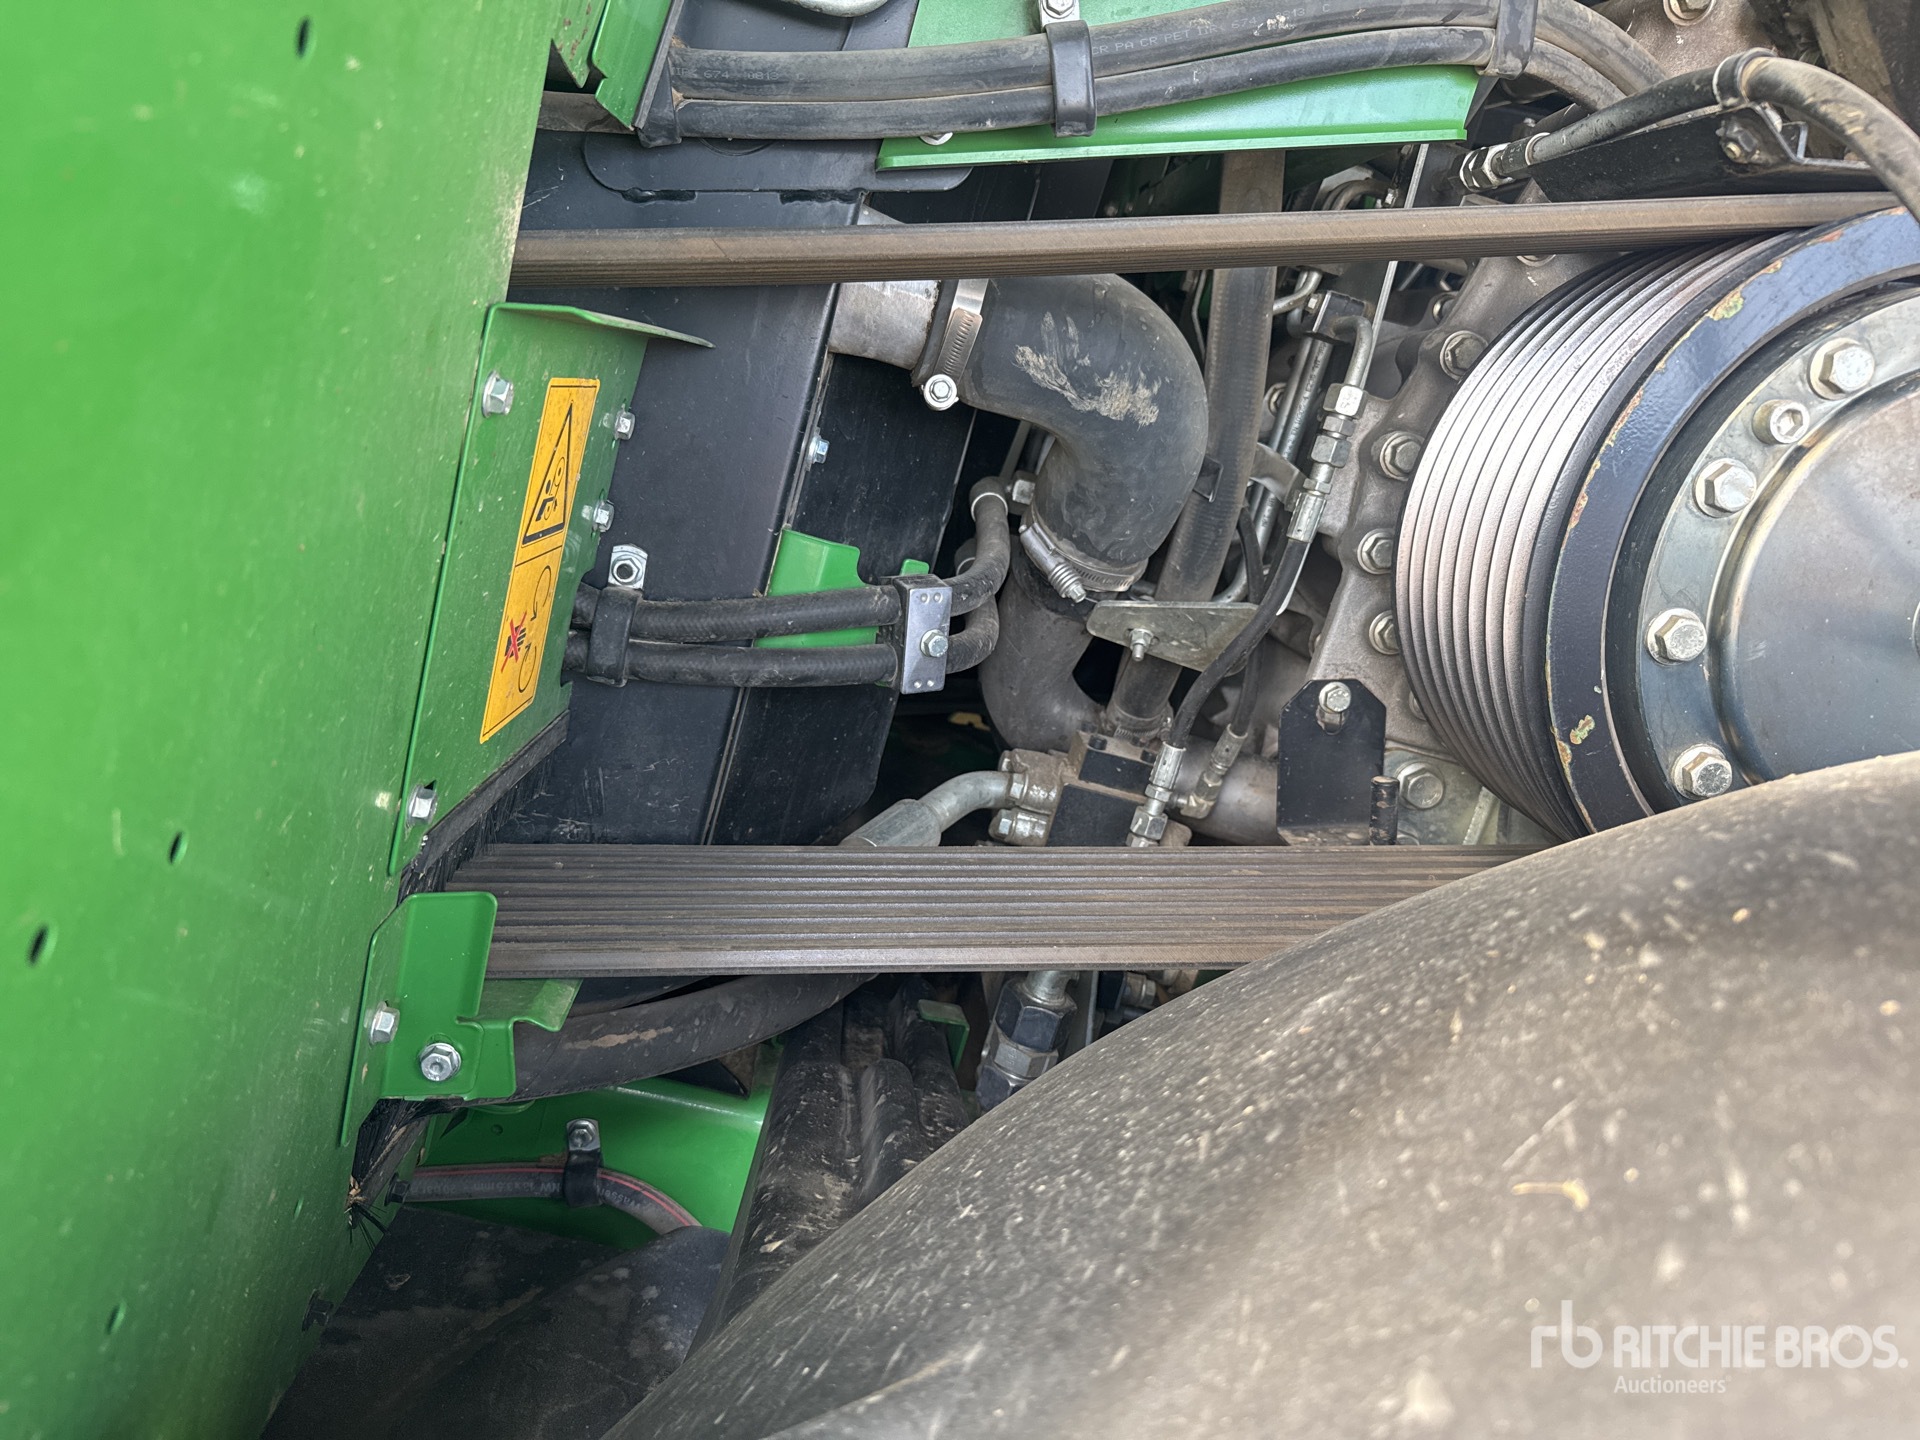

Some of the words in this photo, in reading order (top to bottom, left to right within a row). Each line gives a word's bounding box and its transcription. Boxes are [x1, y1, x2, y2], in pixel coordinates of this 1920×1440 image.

[1114, 41, 1134, 52] PA
[1140, 36, 1158, 47] CR
[1164, 29, 1190, 43] PET
[703, 70, 730, 79] 674
